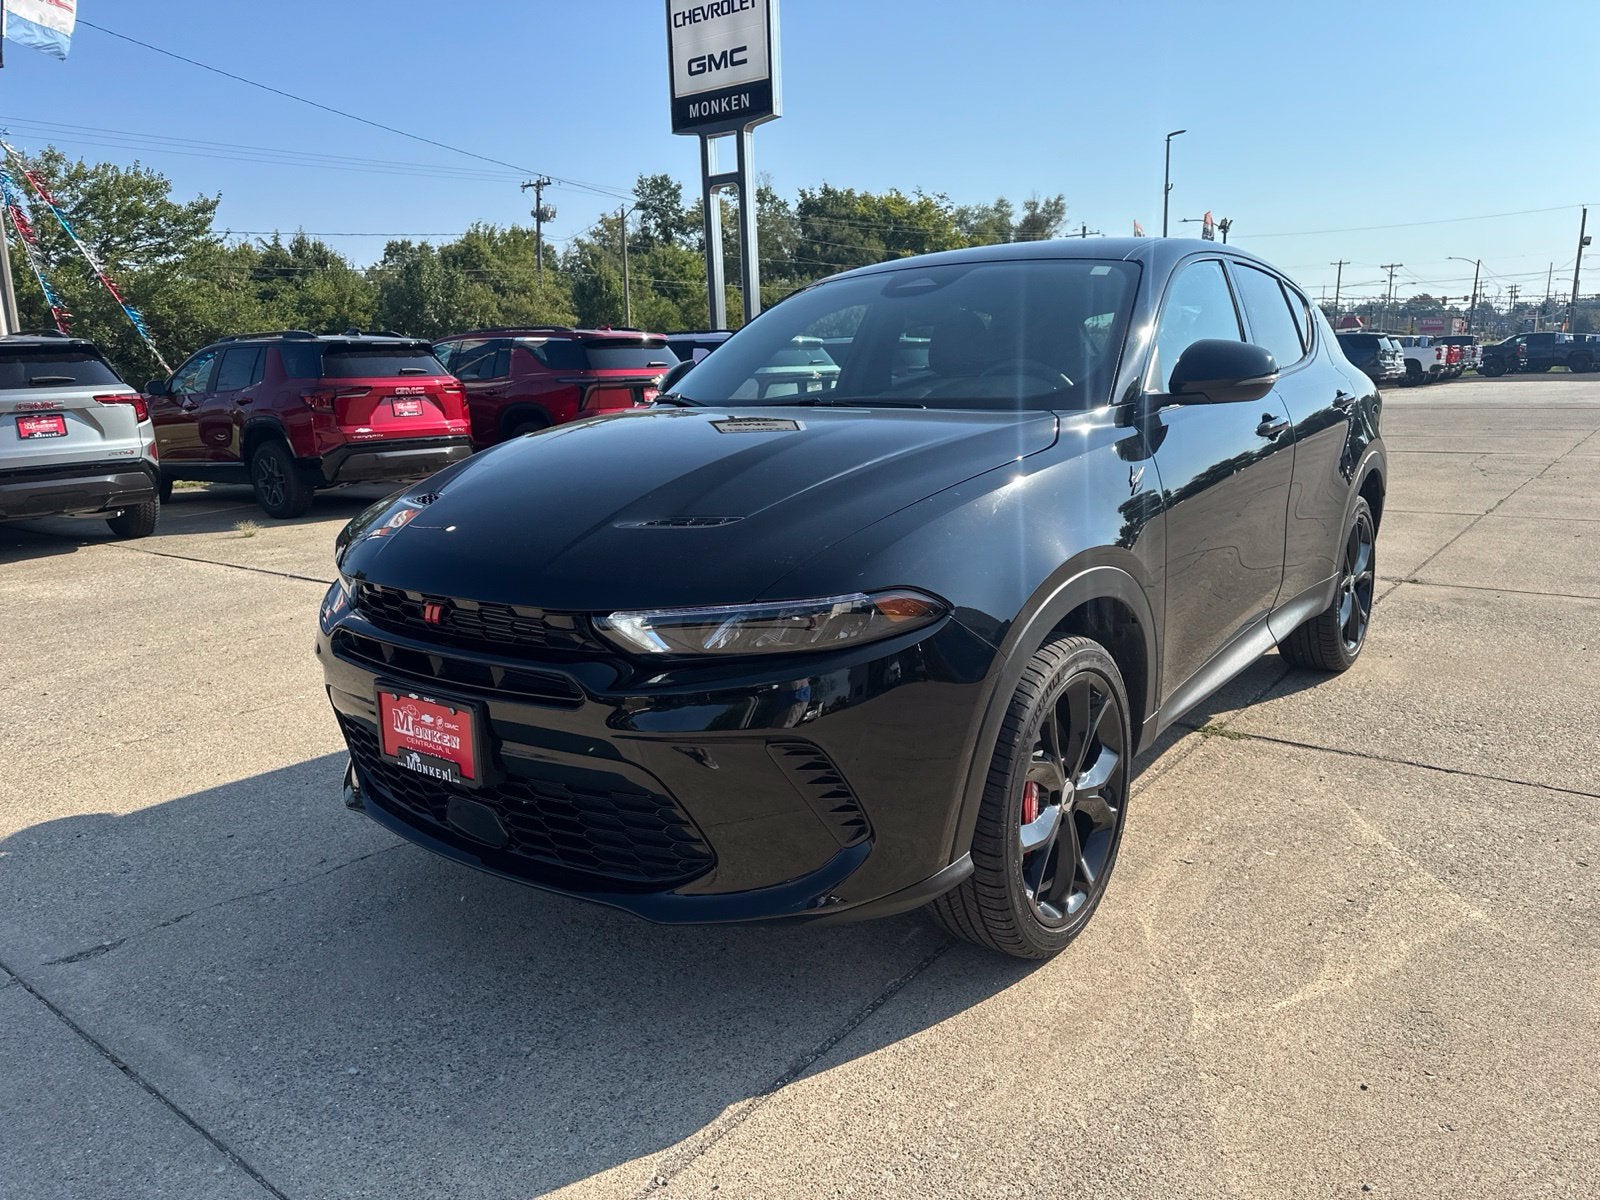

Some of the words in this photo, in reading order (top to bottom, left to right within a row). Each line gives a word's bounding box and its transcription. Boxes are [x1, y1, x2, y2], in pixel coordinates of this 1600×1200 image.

[673, 0, 757, 28] CHEVROLET
[687, 45, 748, 77] GMC
[689, 93, 750, 118] MONKEN
[394, 386, 425, 395] GMC
[15, 400, 64, 411] GMC
[392, 708, 460, 750] MONKEN
[444, 722, 459, 731] GMC
